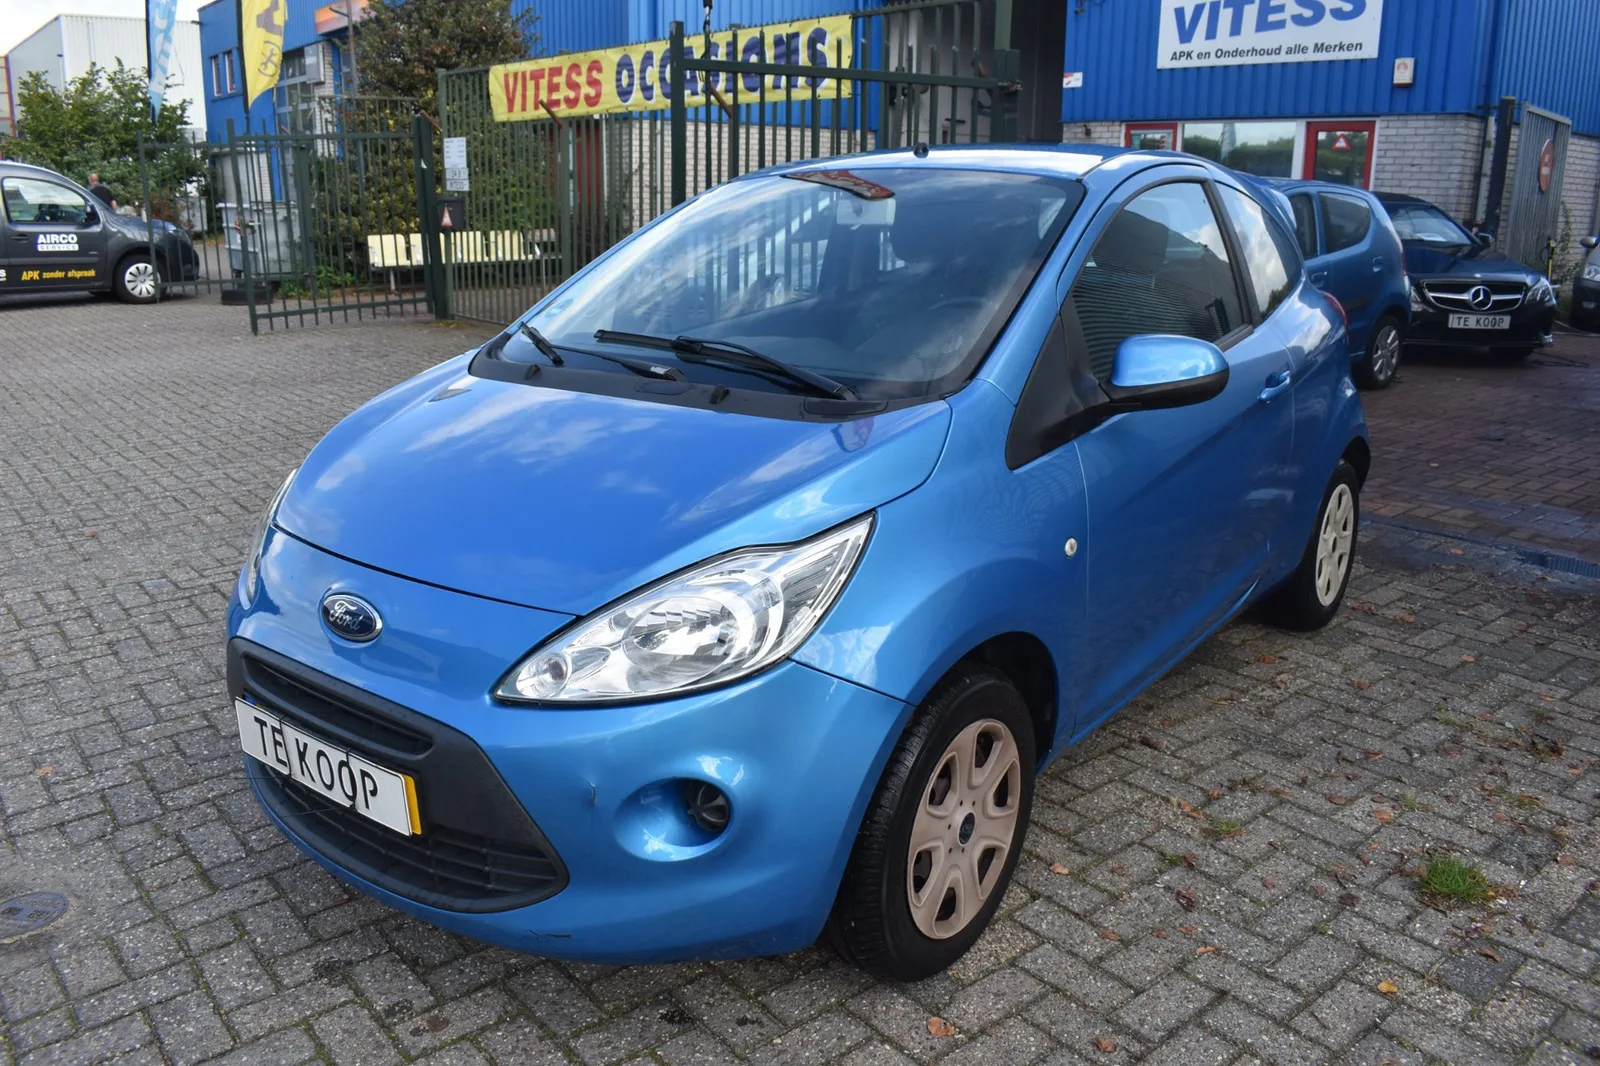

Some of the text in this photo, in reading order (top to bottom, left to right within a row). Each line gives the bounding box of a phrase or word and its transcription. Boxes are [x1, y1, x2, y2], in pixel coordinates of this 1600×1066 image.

[1173, 0, 1367, 45] VITESS
[1170, 41, 1363, 62] APK en Onderhoud alle Merken
[503, 60, 604, 113] VITESS
[38, 234, 77, 243] AIRCO
[21, 268, 96, 280] APK zonder afspraak
[1456, 316, 1505, 328] TE KOOP
[329, 600, 364, 631] Ford
[254, 716, 378, 809] TE KOOP
